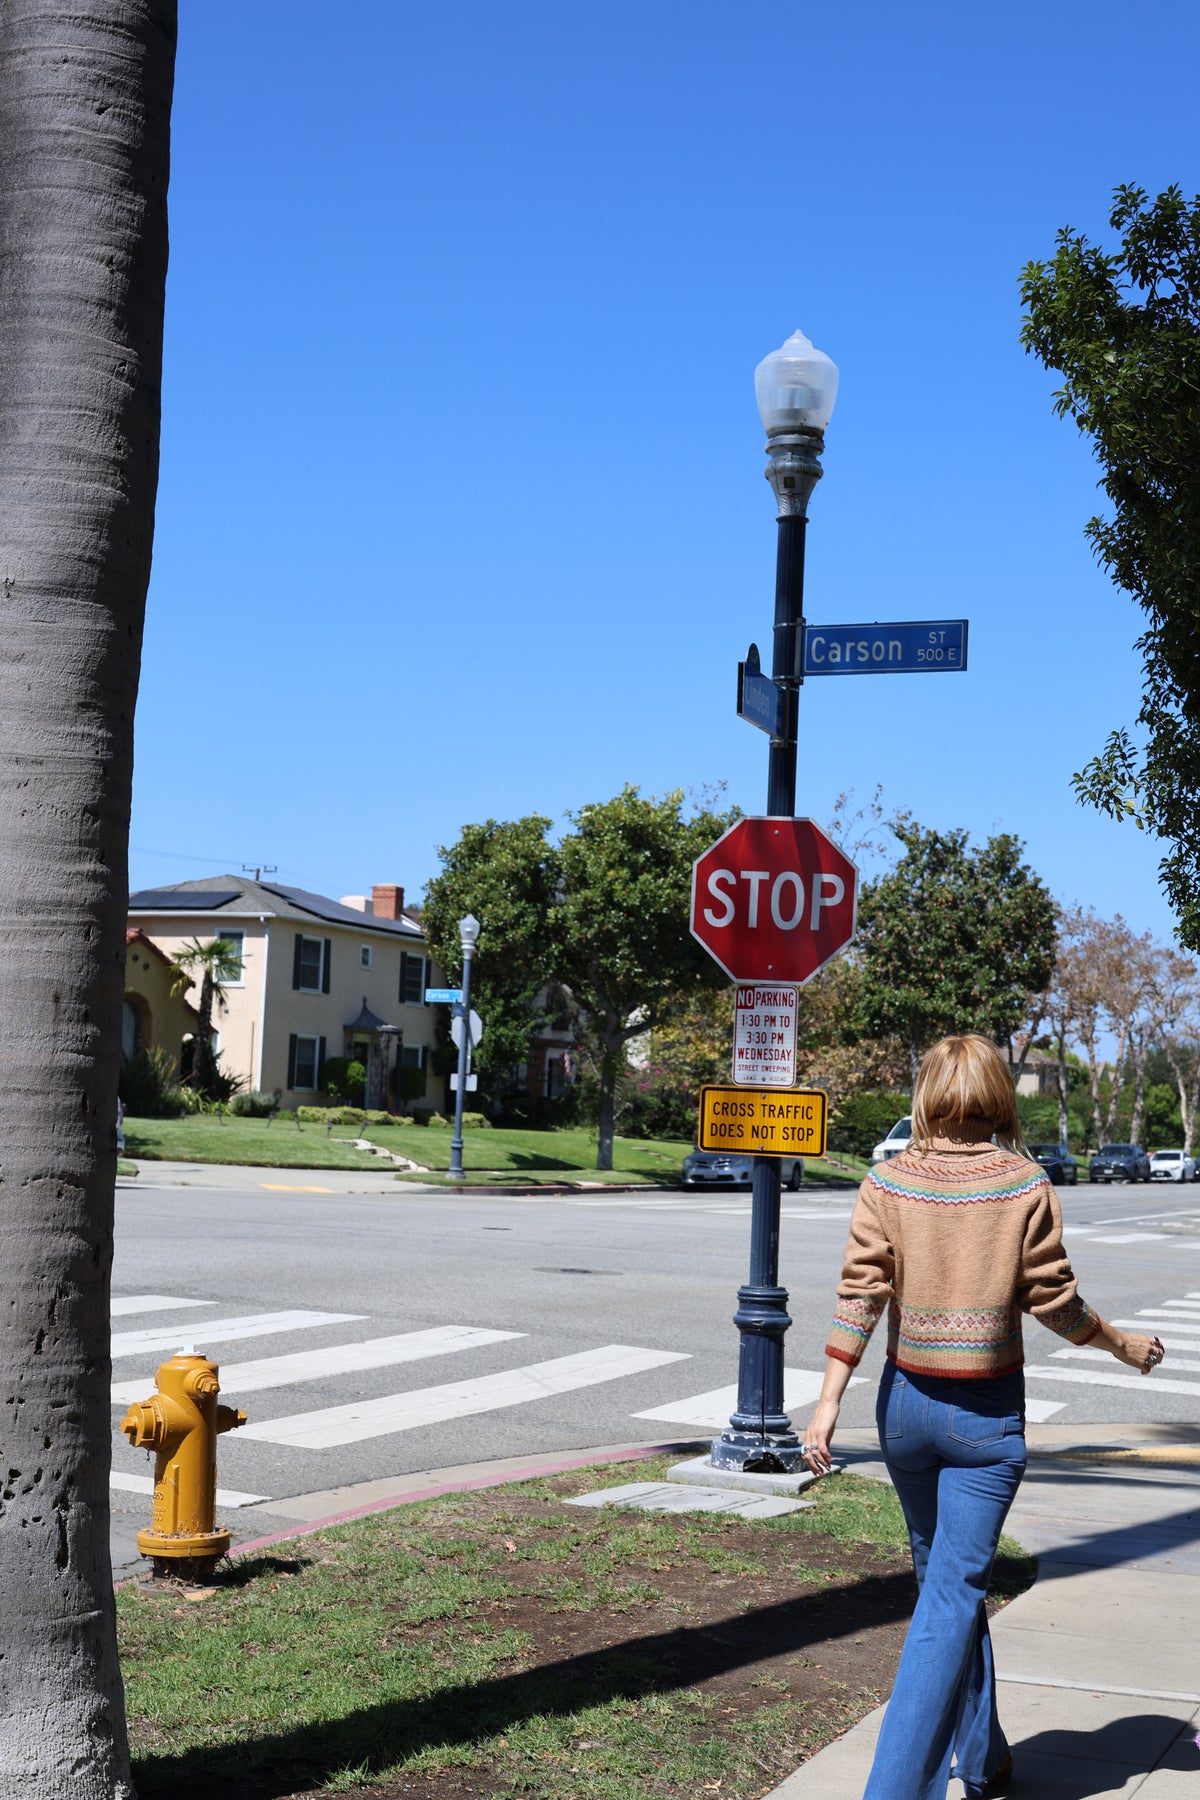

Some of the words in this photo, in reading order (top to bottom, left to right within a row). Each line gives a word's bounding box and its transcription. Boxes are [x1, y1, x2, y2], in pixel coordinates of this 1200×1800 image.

[928, 631, 946, 644] ST
[811, 636, 902, 663] Carson
[917, 649, 944, 662] 500
[948, 648, 956, 661] E
[703, 869, 845, 931] STOP
[737, 989, 754, 1007] NO
[755, 991, 794, 1008] PARKING
[742, 1014, 760, 1027] 1:30
[764, 1015, 776, 1028] PM
[779, 1015, 790, 1028] TO
[746, 1031, 767, 1044] 3:30
[771, 1032, 784, 1045] PM
[737, 1047, 792, 1061] WEDNESDAY
[737, 1064, 759, 1072] STREET
[761, 1064, 791, 1073] SWEEPING
[713, 1101, 755, 1117] CROSS
[761, 1103, 813, 1120] TRAFFIC
[710, 1122, 744, 1138] DOES
[751, 1125, 776, 1140] NOT
[782, 1126, 814, 1141] STOP
